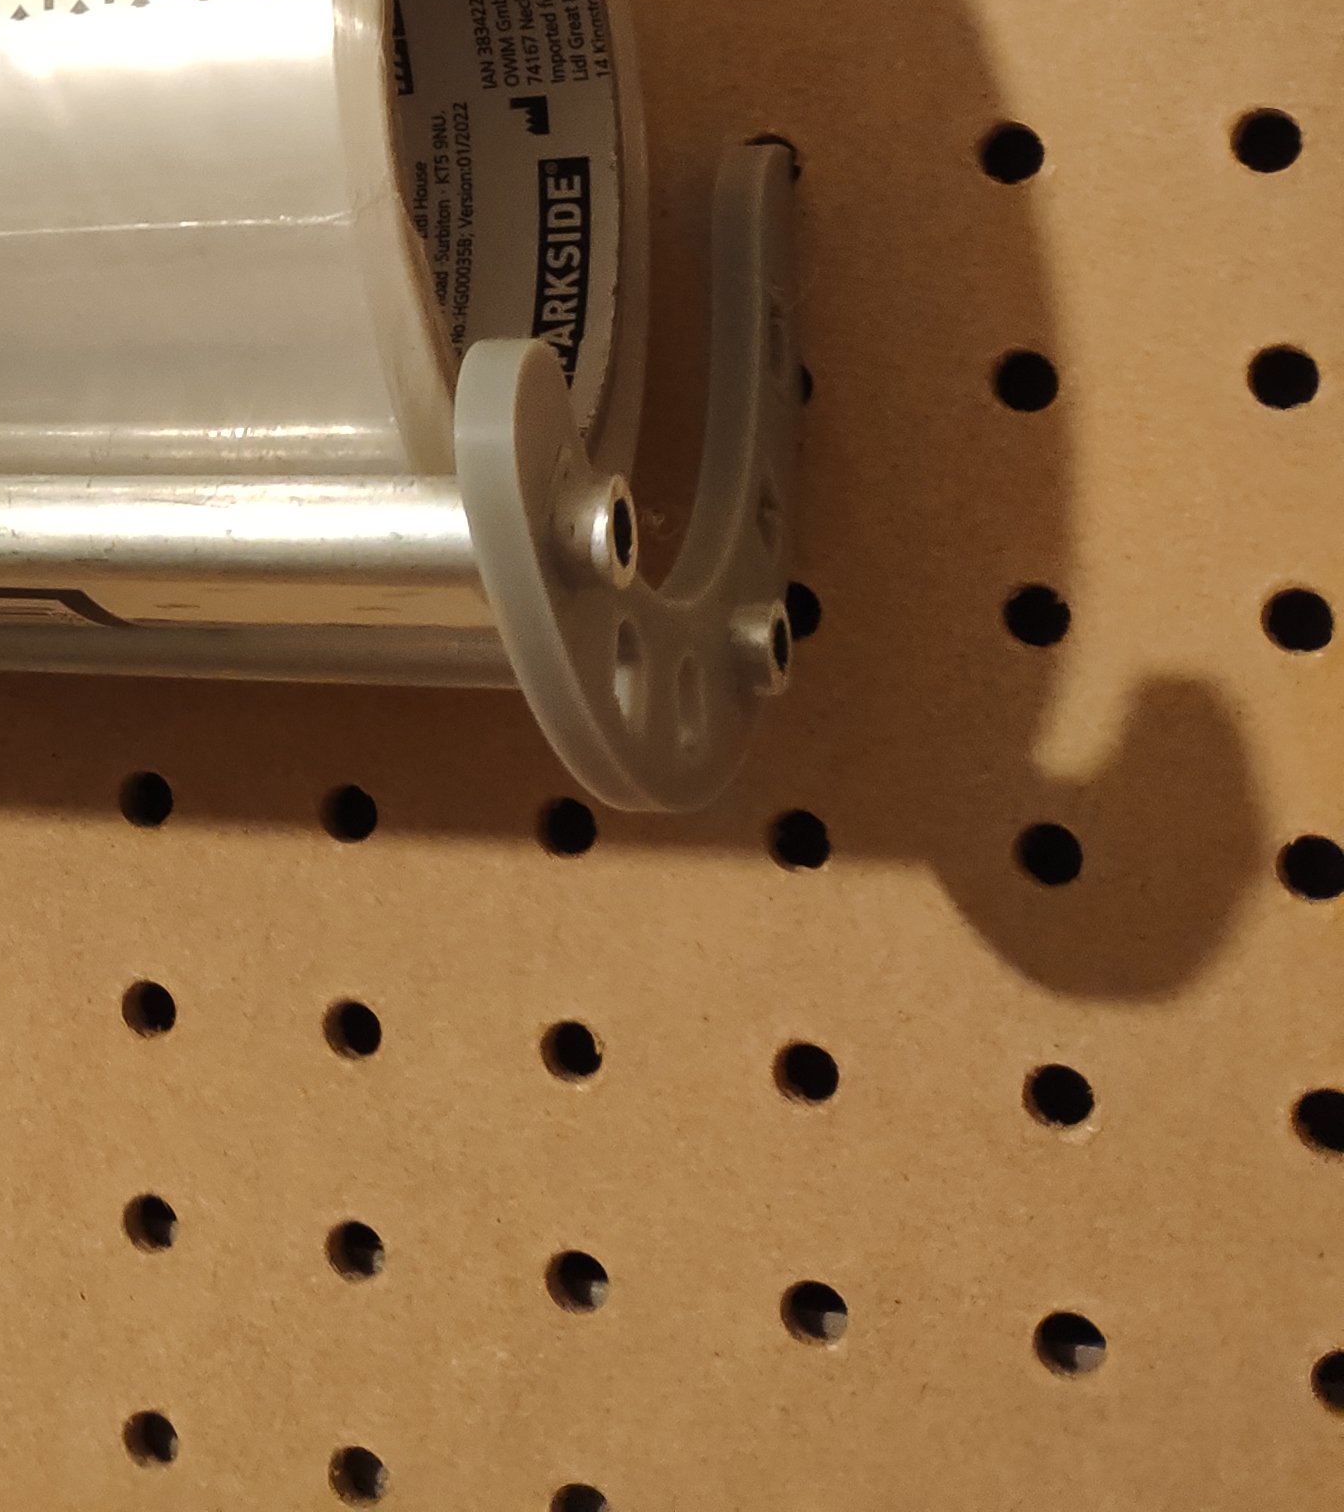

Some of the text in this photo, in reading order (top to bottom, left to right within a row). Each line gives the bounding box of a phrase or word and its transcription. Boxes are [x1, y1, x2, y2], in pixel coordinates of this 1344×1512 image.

[540, 13, 566, 84] Imported
[564, 5, 585, 50] Great
[481, 61, 498, 90] IAN
[499, 36, 520, 87] OWIM
[521, 36, 543, 85] 74167
[570, 54, 589, 81] Lidl
[594, 57, 610, 78] 14
[413, 161, 428, 211] House
[433, 154, 450, 186] KT5
